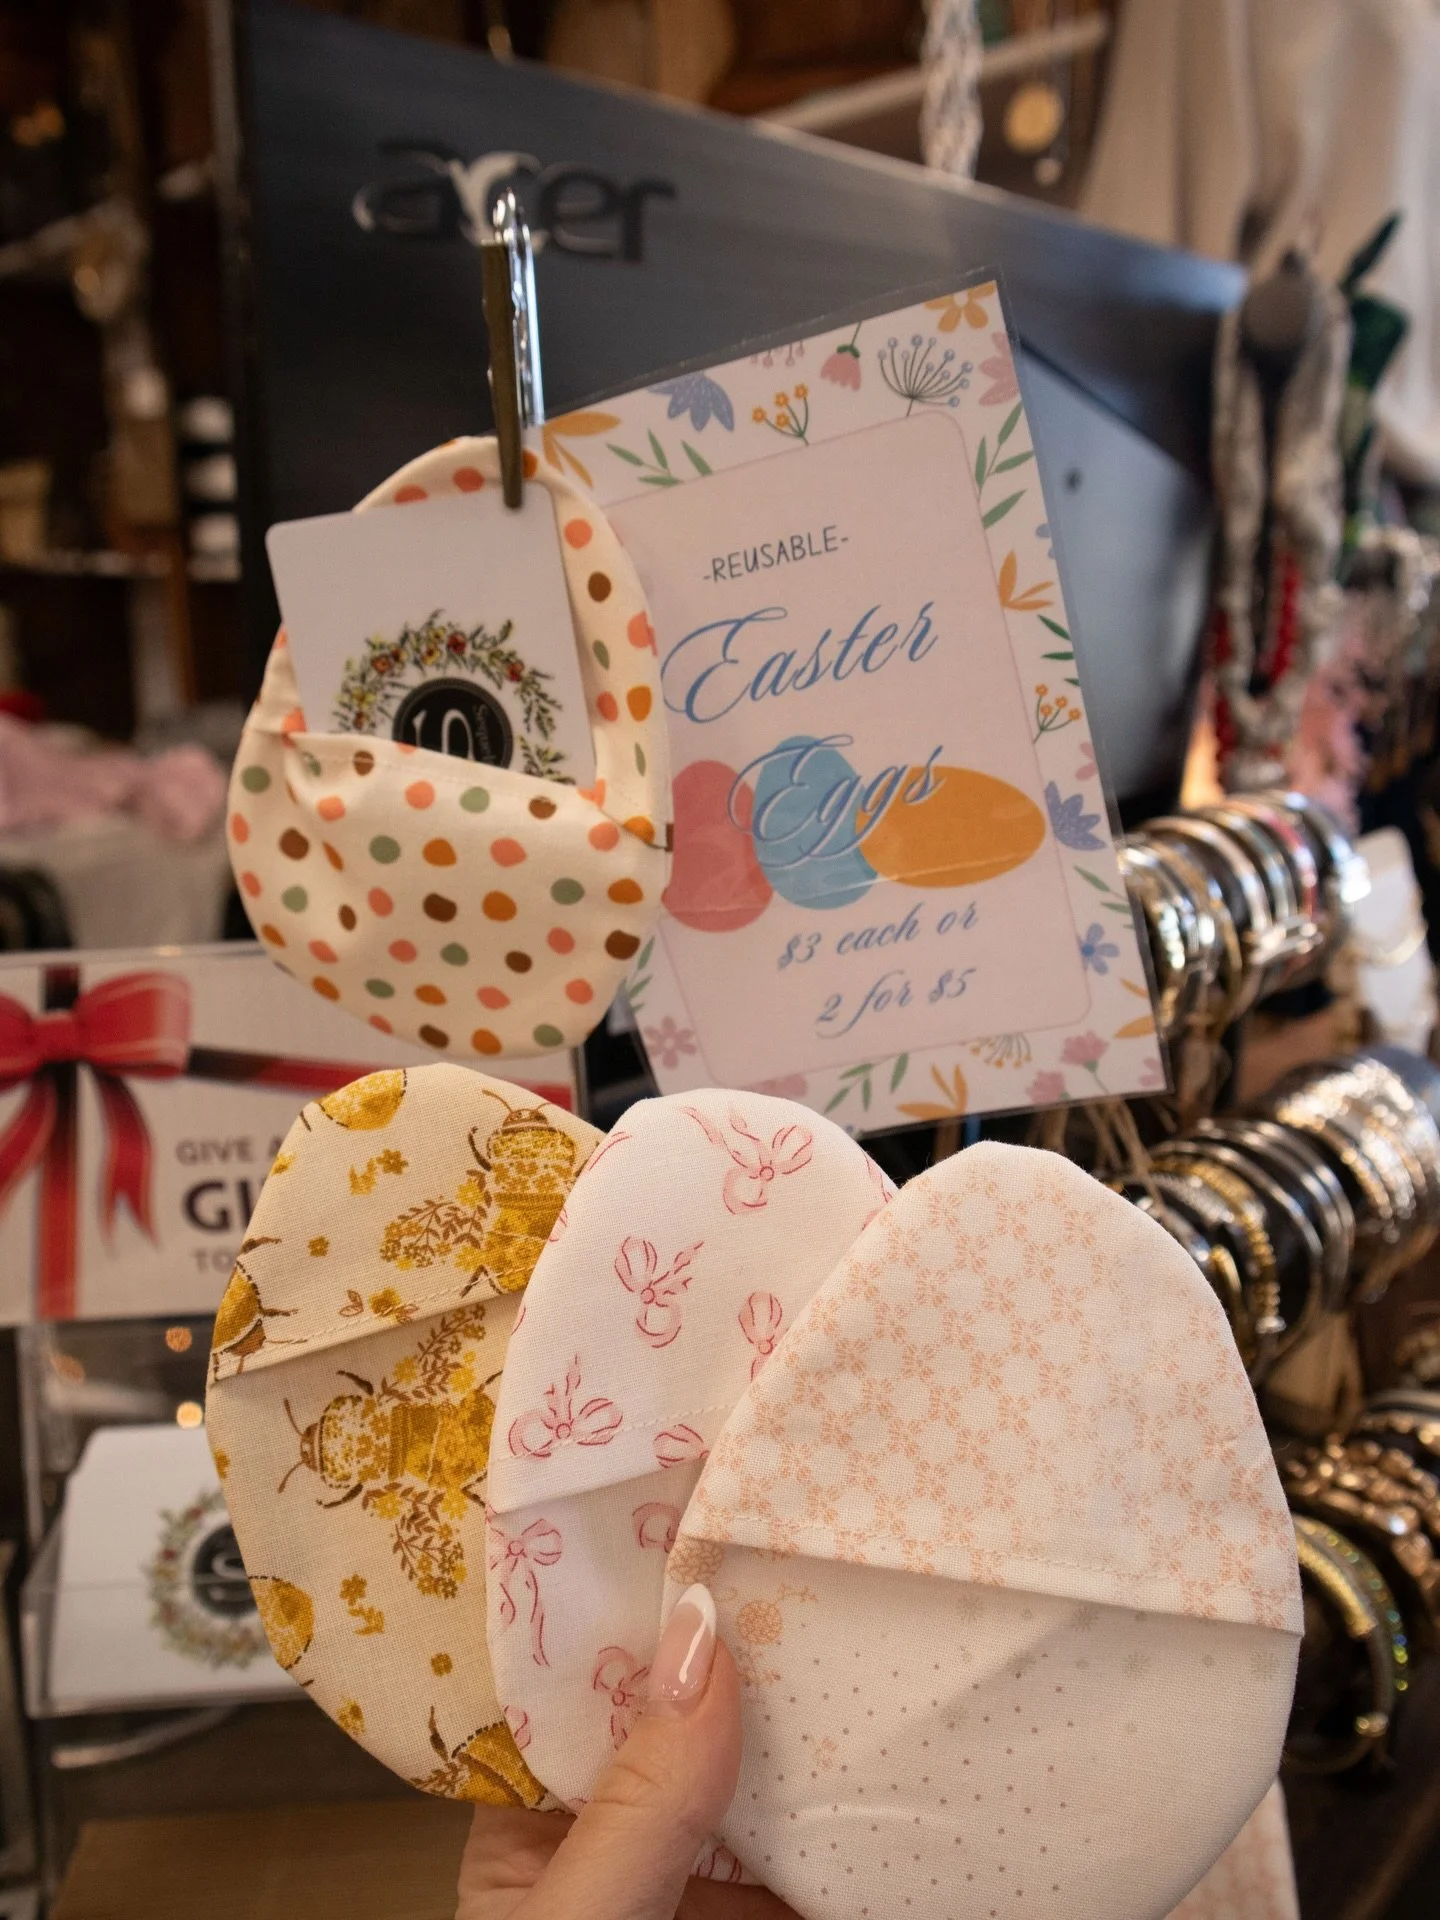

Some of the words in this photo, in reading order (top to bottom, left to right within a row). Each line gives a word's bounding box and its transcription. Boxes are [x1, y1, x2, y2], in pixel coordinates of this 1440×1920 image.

[352, 138, 677, 264] acer
[703, 525, 849, 583] -REUSABLE-
[660, 601, 939, 724] Easter
[727, 734, 946, 870] Eggs
[777, 932, 822, 971] $3
[836, 901, 925, 955] each
[936, 901, 979, 935] or
[815, 993, 843, 1025] 2
[816, 969, 914, 1040] for
[927, 967, 977, 1004] $5
[175, 1138, 253, 1166] GIVE
